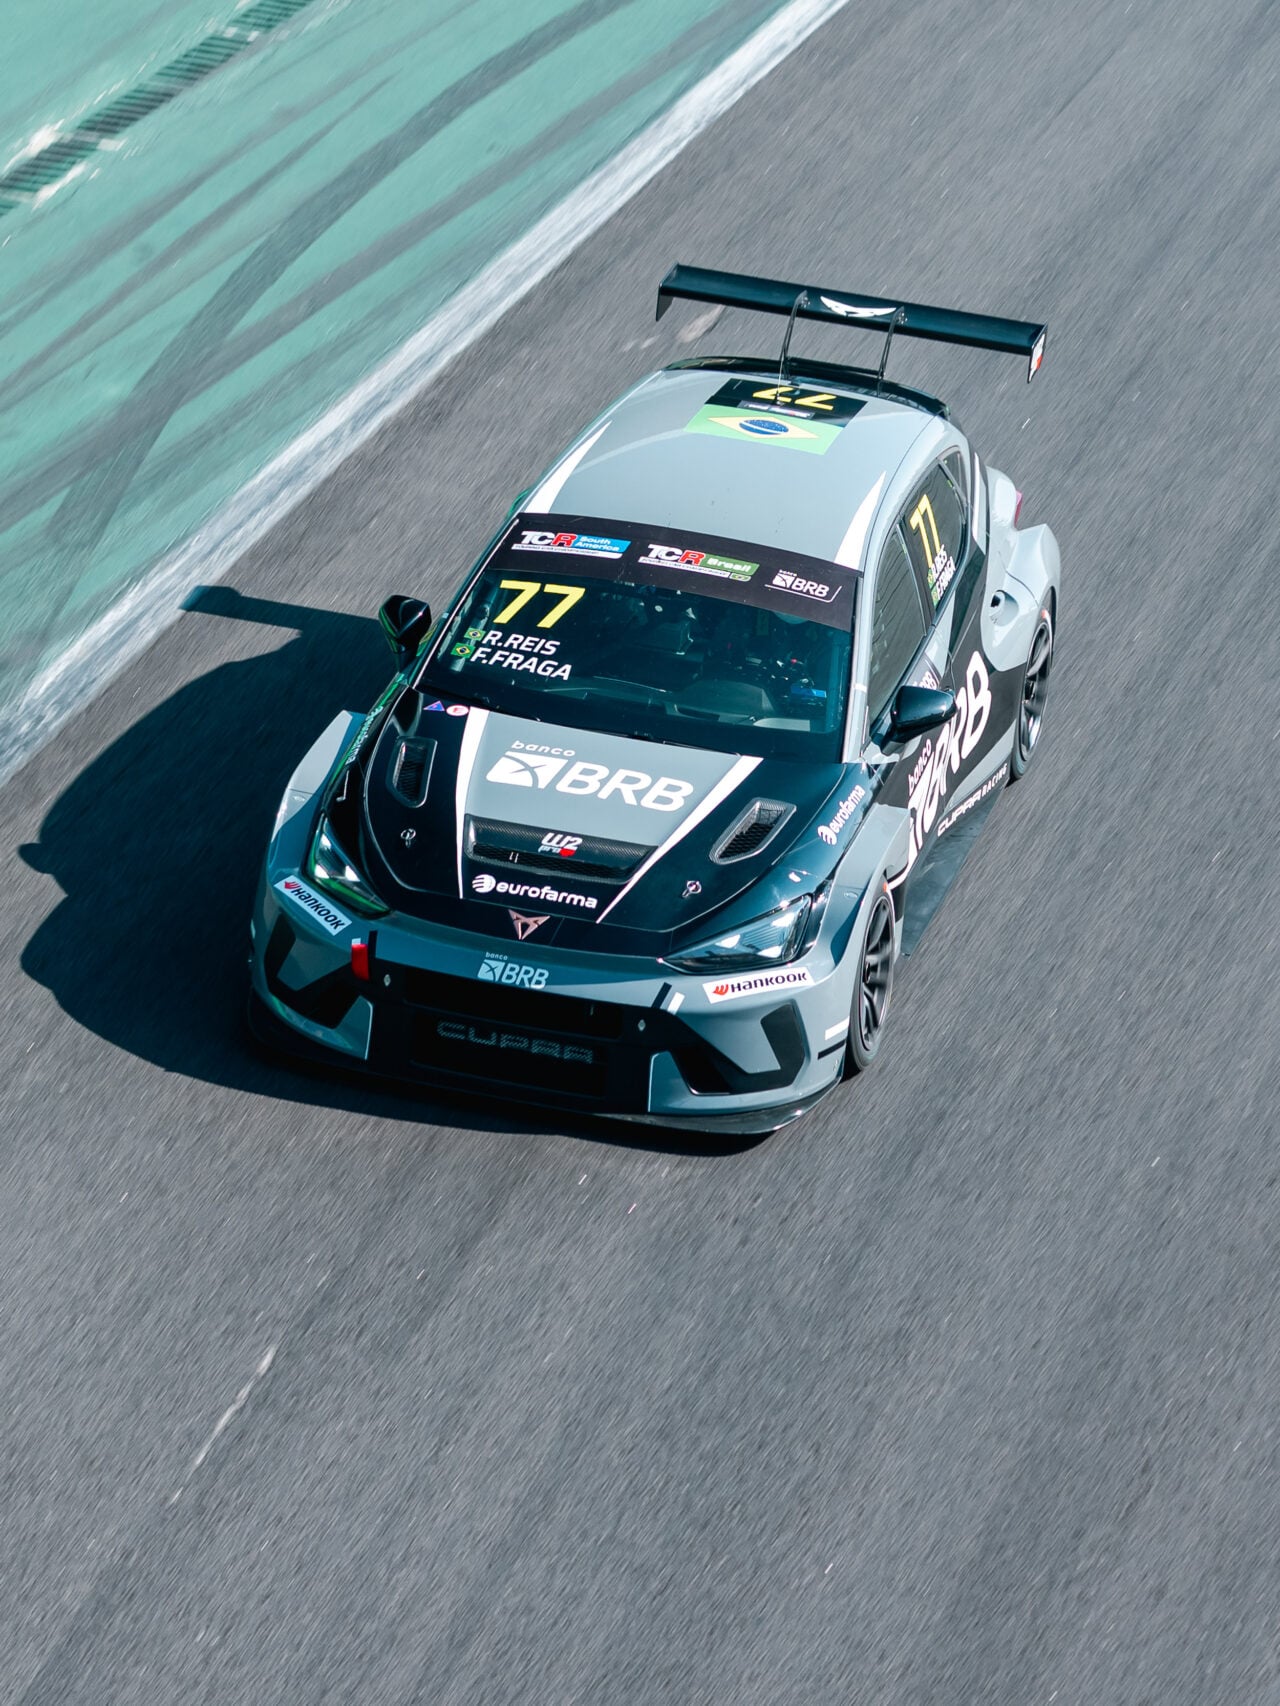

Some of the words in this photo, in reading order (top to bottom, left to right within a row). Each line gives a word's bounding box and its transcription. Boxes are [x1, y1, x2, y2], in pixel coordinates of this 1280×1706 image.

[521, 531, 577, 547] TCR
[574, 542, 620, 552] America
[579, 536, 612, 545] South
[648, 544, 706, 566] TCR
[791, 577, 830, 597] BRB
[493, 580, 586, 629] 77
[482, 630, 561, 655] R.REIS
[470, 647, 572, 681] F.FRAGA
[511, 740, 576, 757] banco
[908, 738, 932, 796] banco
[555, 761, 694, 812] BRB
[829, 784, 866, 834] eurofarma
[496, 881, 598, 909] eurofarma
[485, 952, 508, 961] banco
[501, 963, 549, 990] BRB
[437, 1021, 593, 1064] CUPRA
